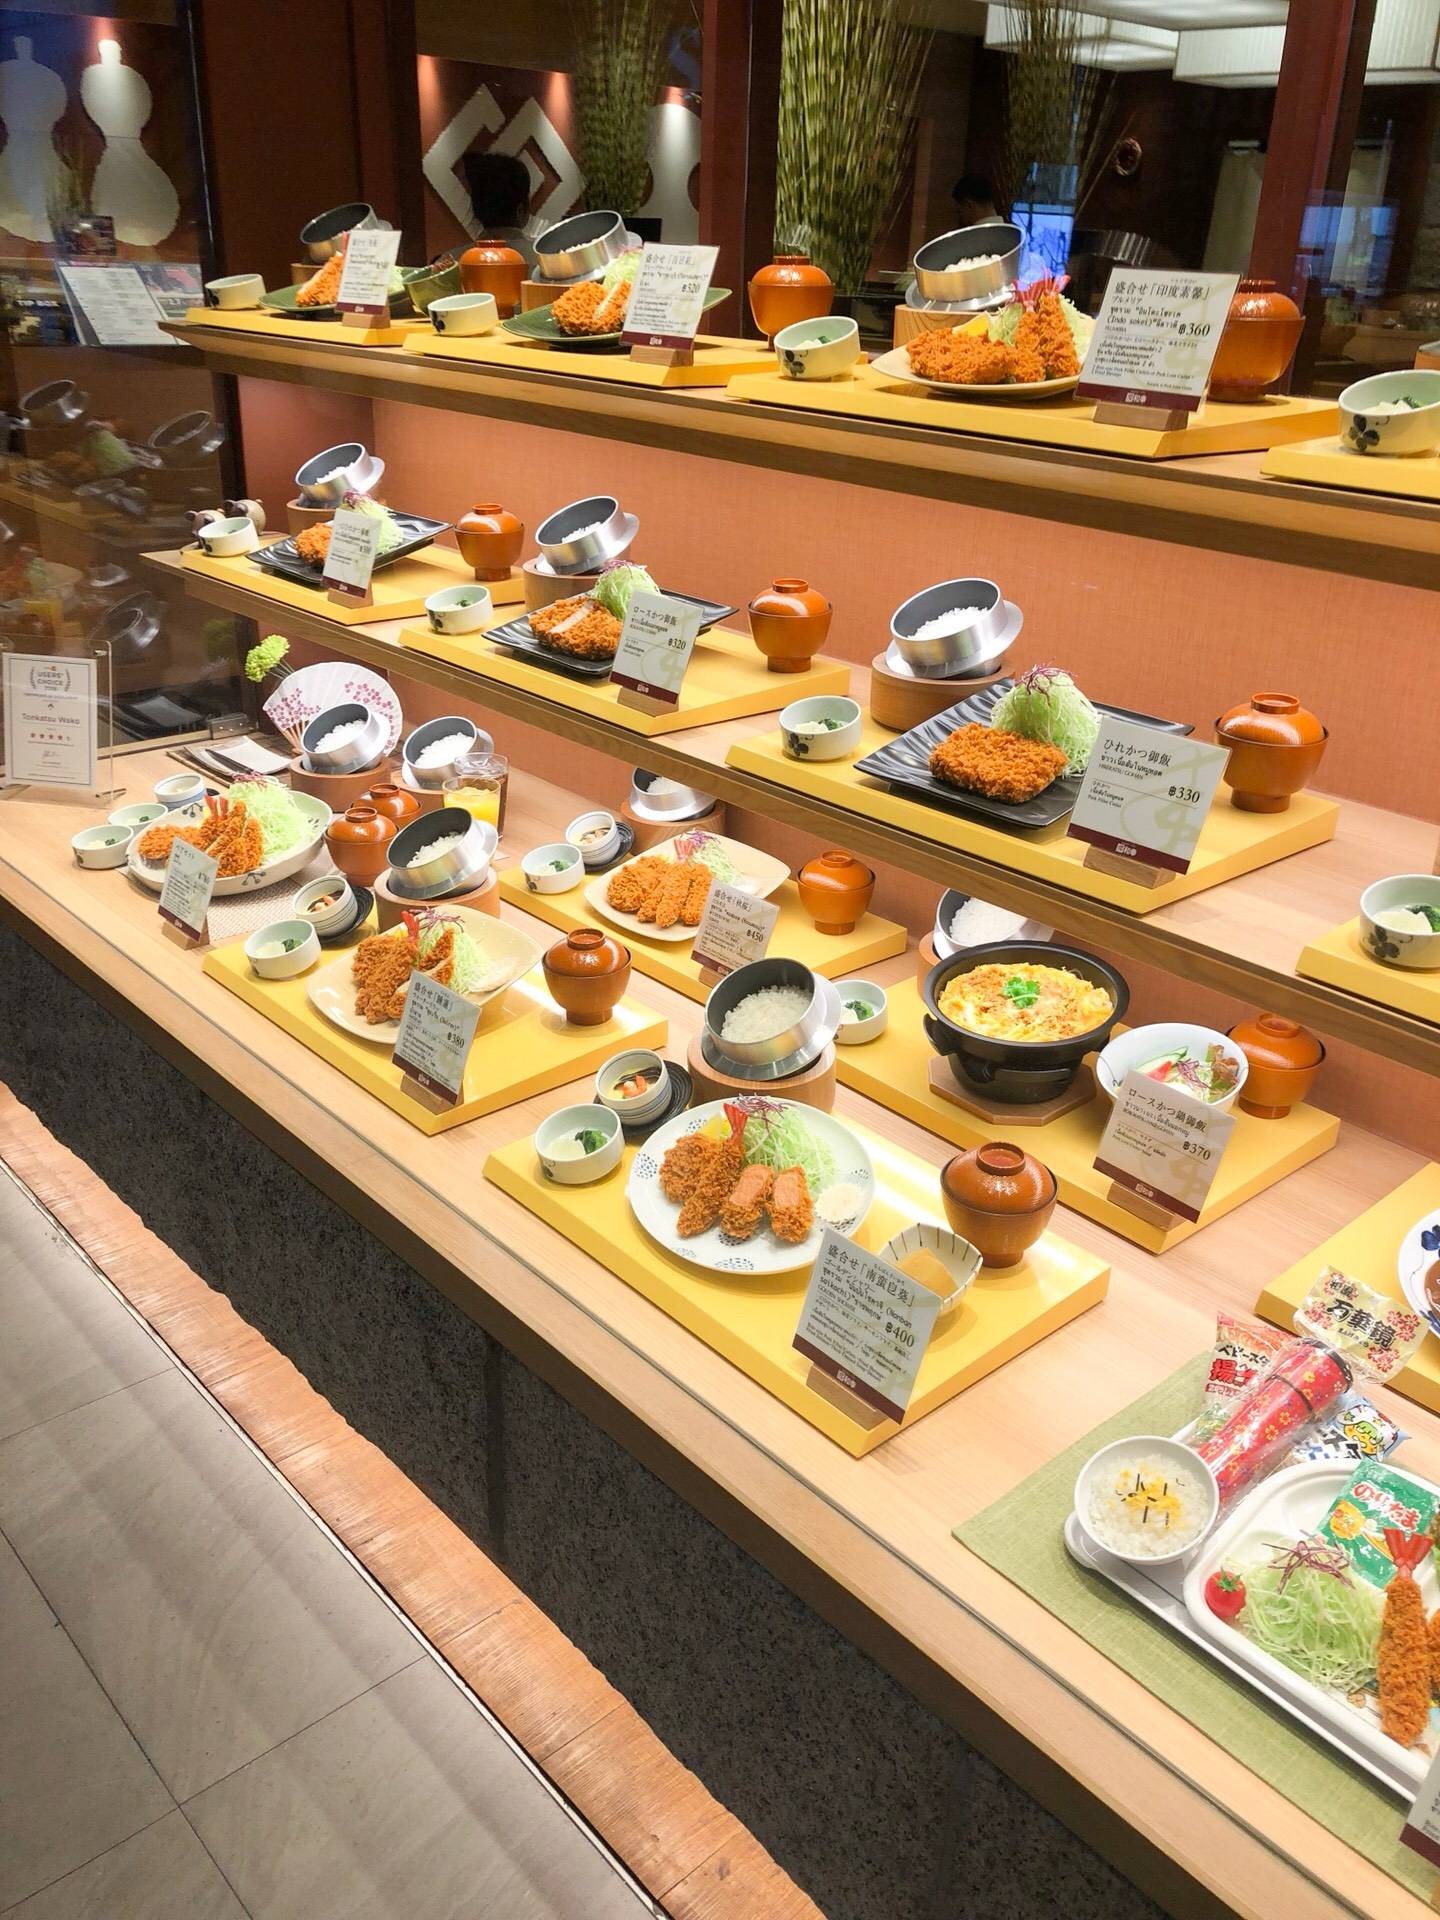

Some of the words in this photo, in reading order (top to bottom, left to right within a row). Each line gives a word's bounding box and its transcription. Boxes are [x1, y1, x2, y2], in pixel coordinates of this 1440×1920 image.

[1178, 323, 1210, 336] ฿360
[668, 638, 686, 650] ฿320
[1104, 739, 1171, 766] ひれかつ御飯
[1168, 786, 1200, 803] ฿330
[746, 929, 763, 942] ฿450
[447, 1032, 464, 1048] ฿380
[1129, 1088, 1207, 1132] ロースかつ鍋御飯
[1182, 1141, 1211, 1160] ฿370
[1326, 1298, 1397, 1349] 万華鏡
[885, 1321, 914, 1347] ฿400
